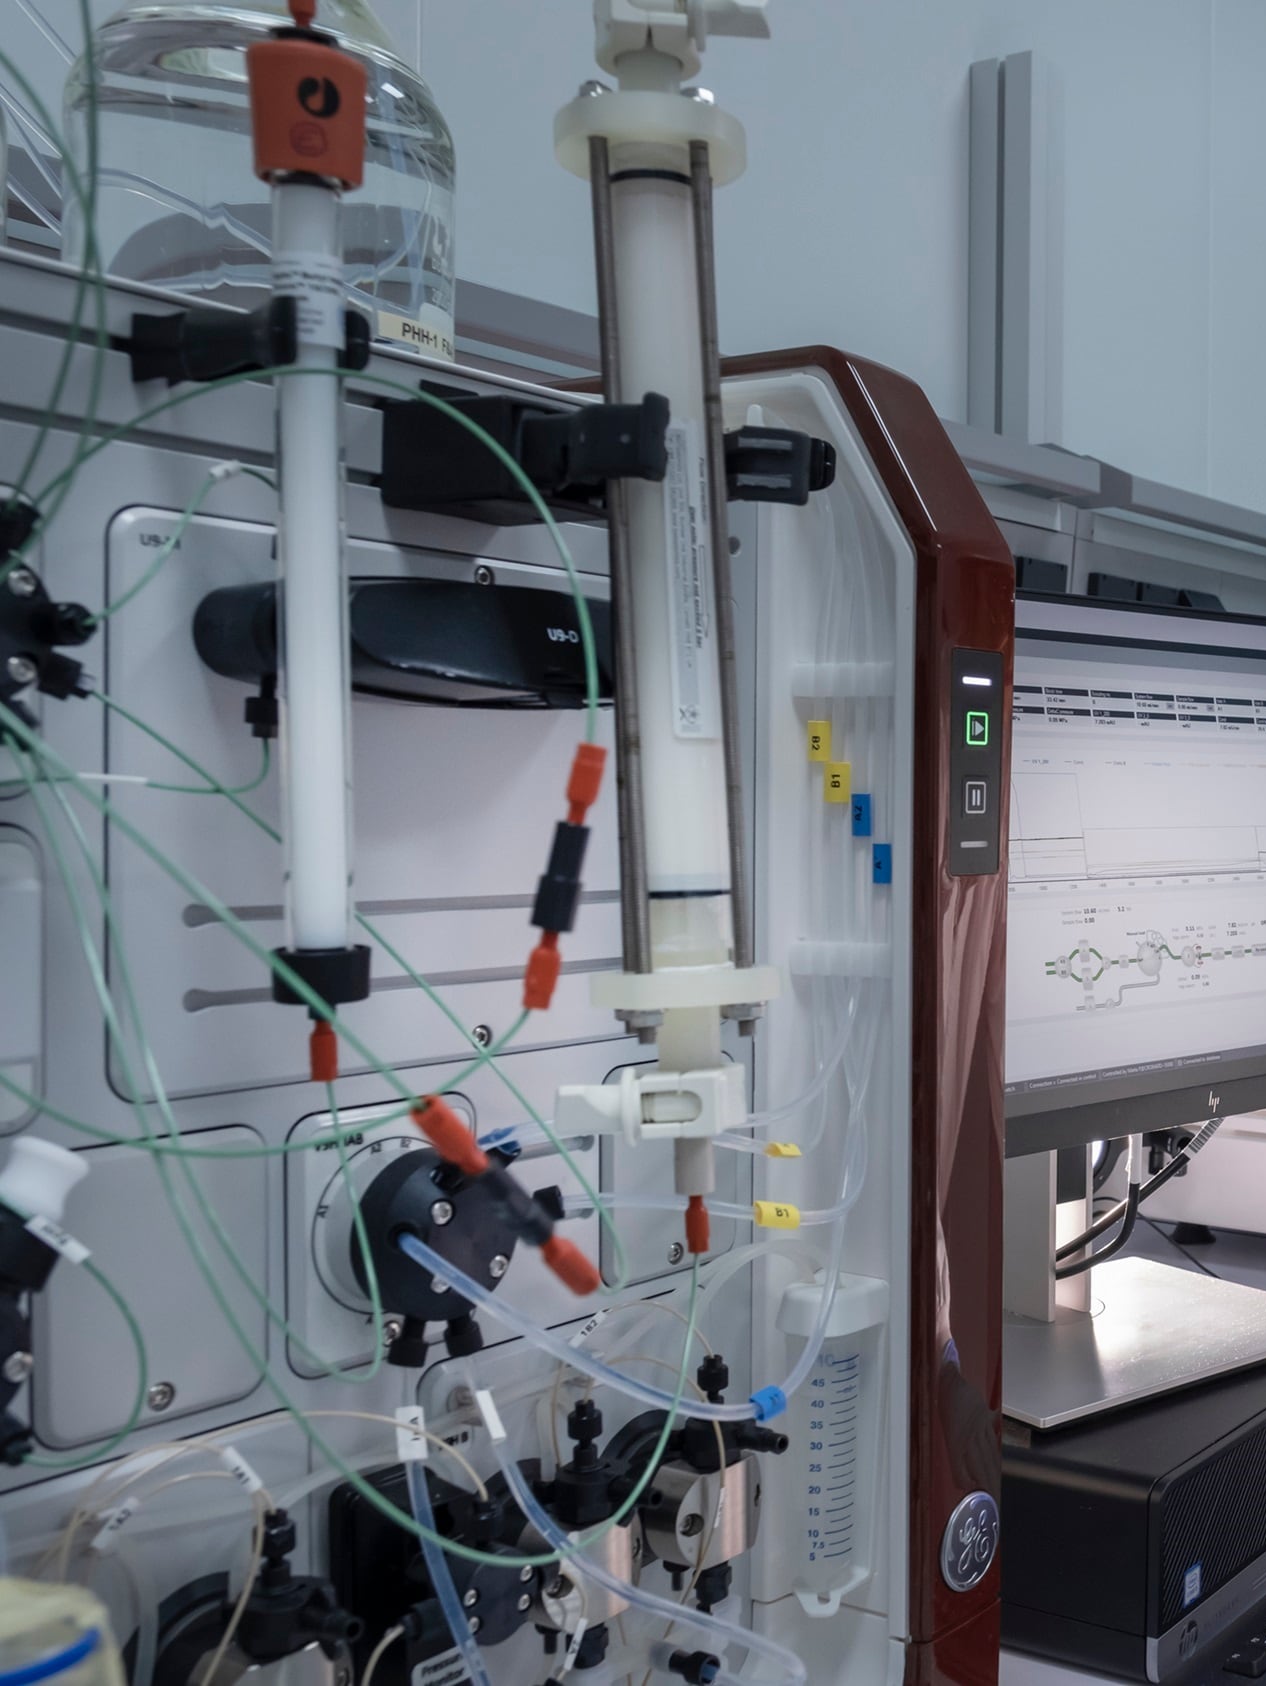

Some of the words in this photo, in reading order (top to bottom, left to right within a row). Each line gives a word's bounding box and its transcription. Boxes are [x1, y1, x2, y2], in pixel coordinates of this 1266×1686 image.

[401, 322, 438, 349] PHH-1
[811, 735, 821, 751] B2
[831, 773, 841, 788] B1
[580, 1319, 598, 1336] 1B2
[811, 1378, 825, 1388] 45
[811, 1400, 825, 1409] 40
[810, 1421, 824, 1430] 35
[809, 1441, 823, 1451] 30
[808, 1464, 822, 1473] 25
[808, 1485, 821, 1494] 20
[808, 1507, 820, 1516] 15
[807, 1529, 820, 1538] 10
[812, 1541, 825, 1549] 7.5
[809, 1552, 816, 1561] 5
